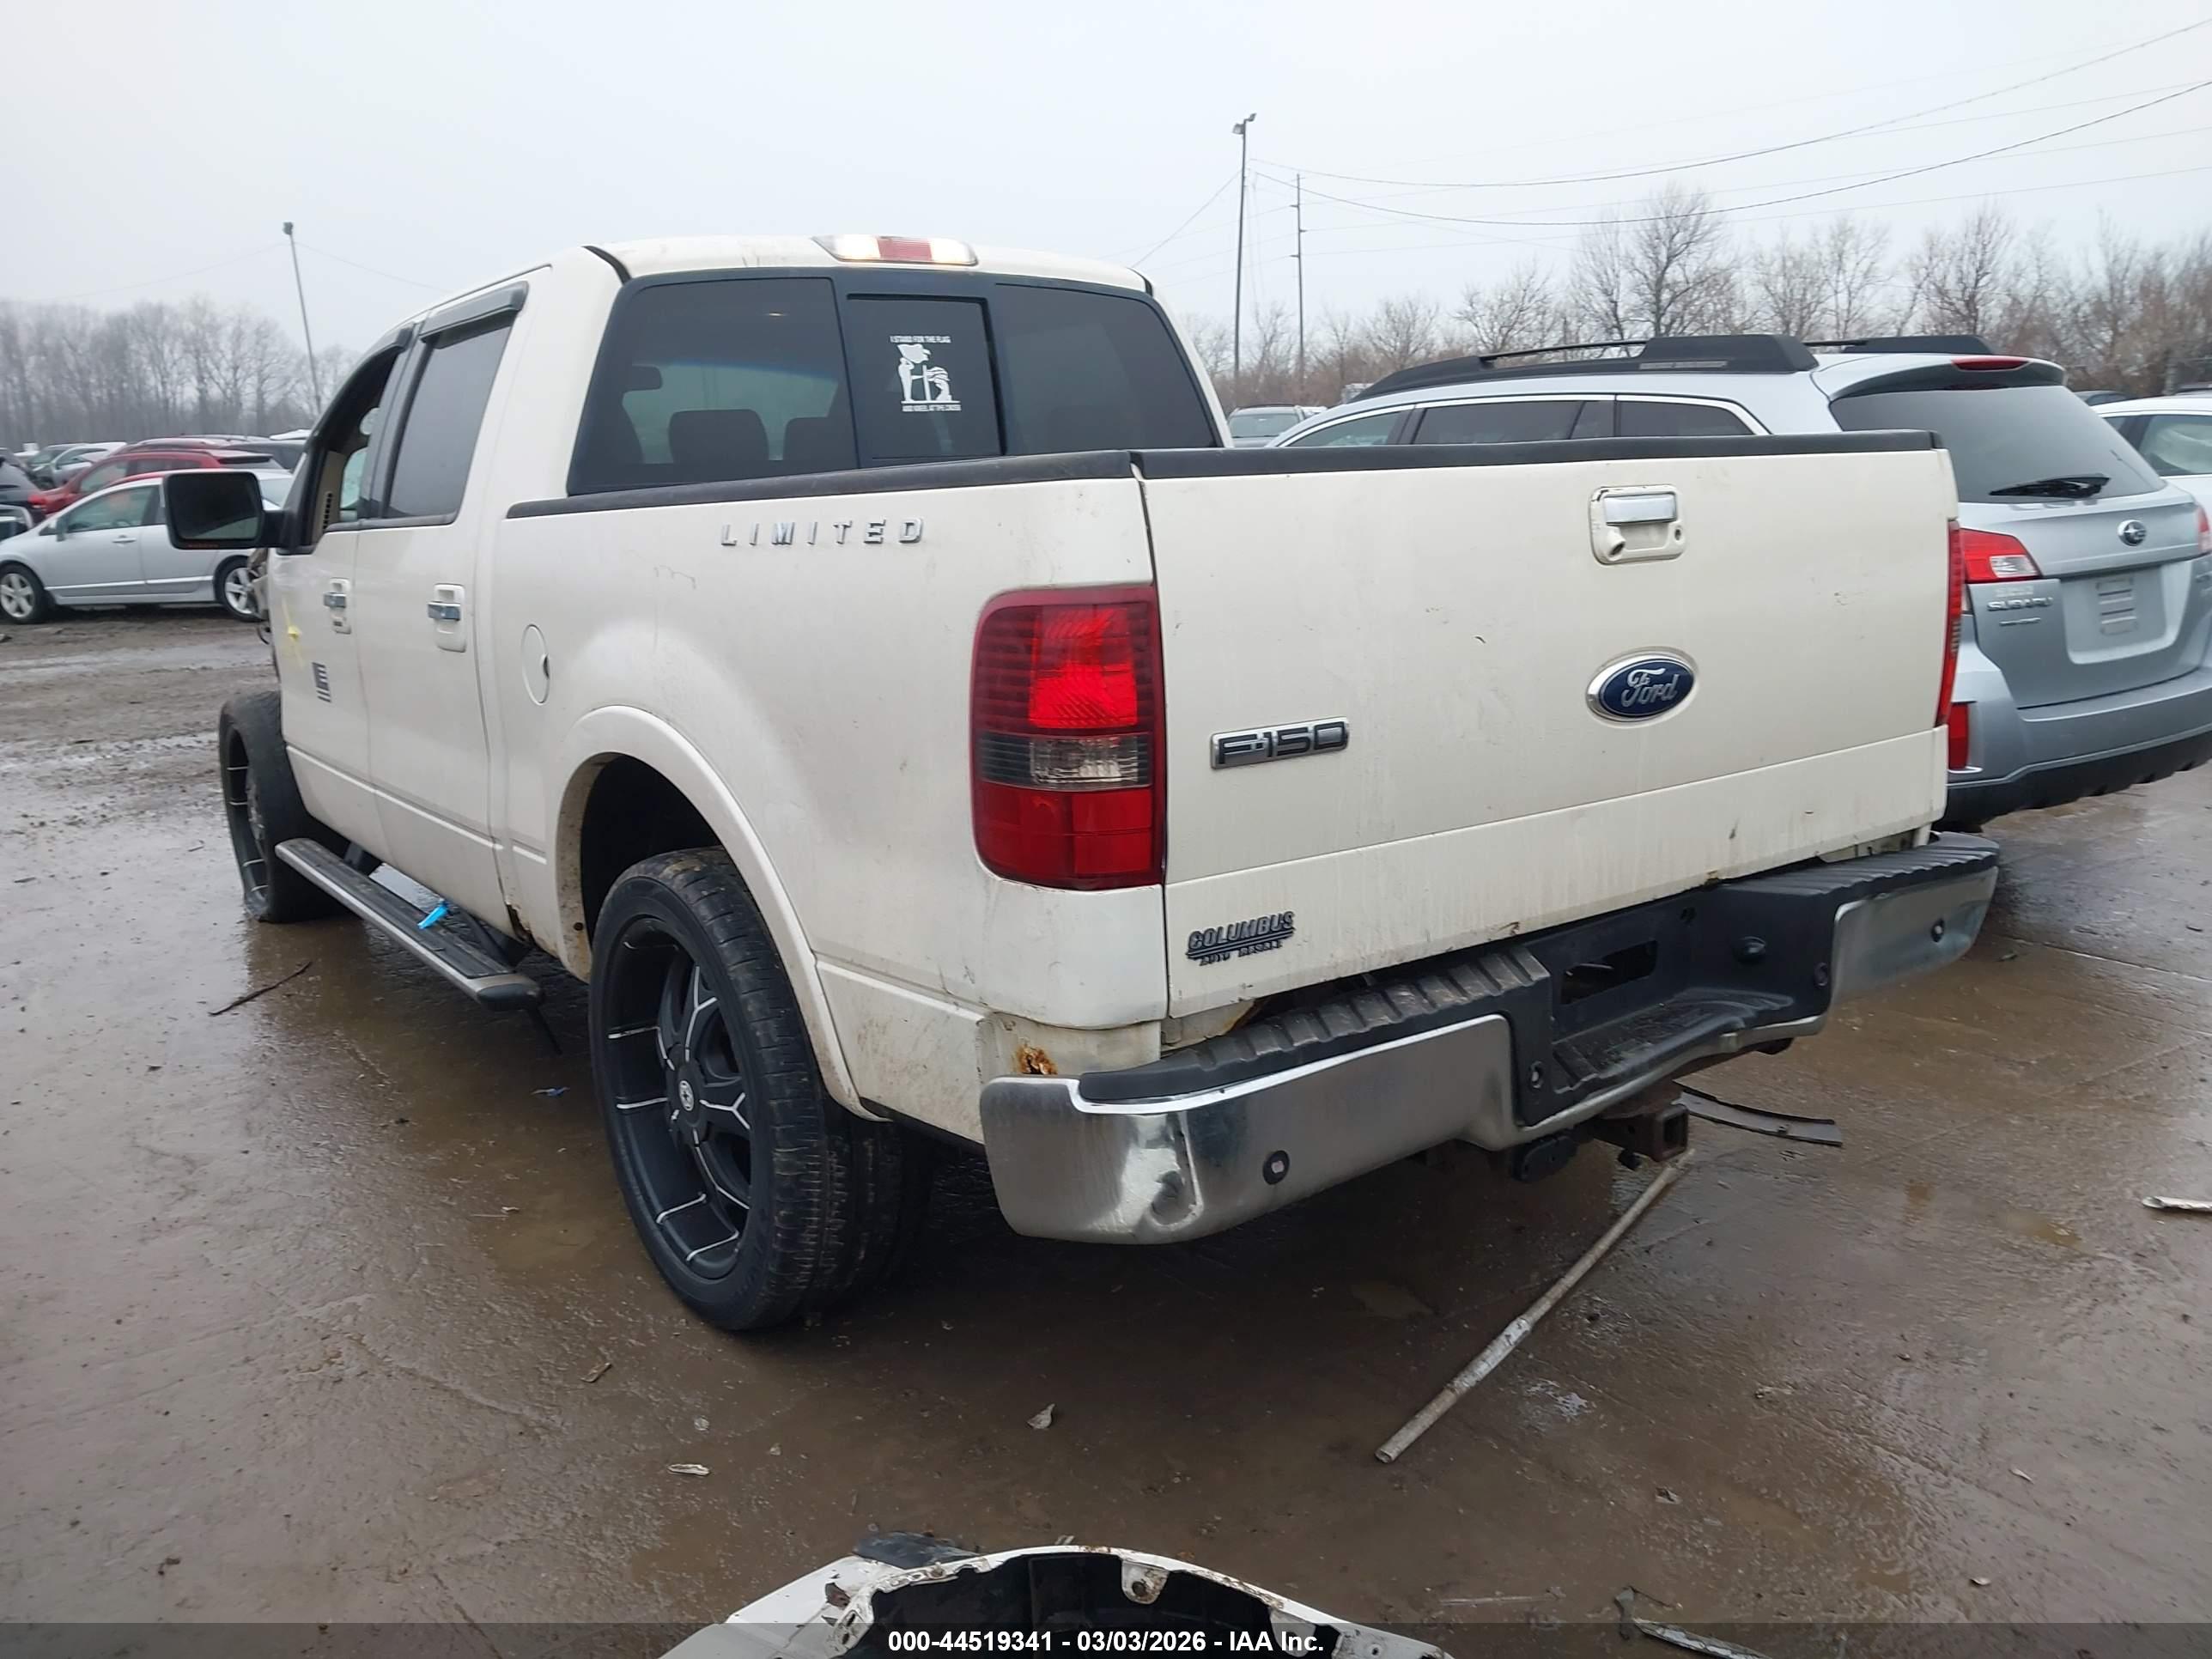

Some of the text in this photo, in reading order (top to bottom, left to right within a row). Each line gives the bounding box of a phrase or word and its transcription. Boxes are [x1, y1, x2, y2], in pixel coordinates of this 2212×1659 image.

[720, 518, 925, 546] LIMITED
[1620, 667, 1680, 708] Ford
[1218, 721, 1346, 764] F-150
[1188, 910, 1294, 950] COLUMBUS
